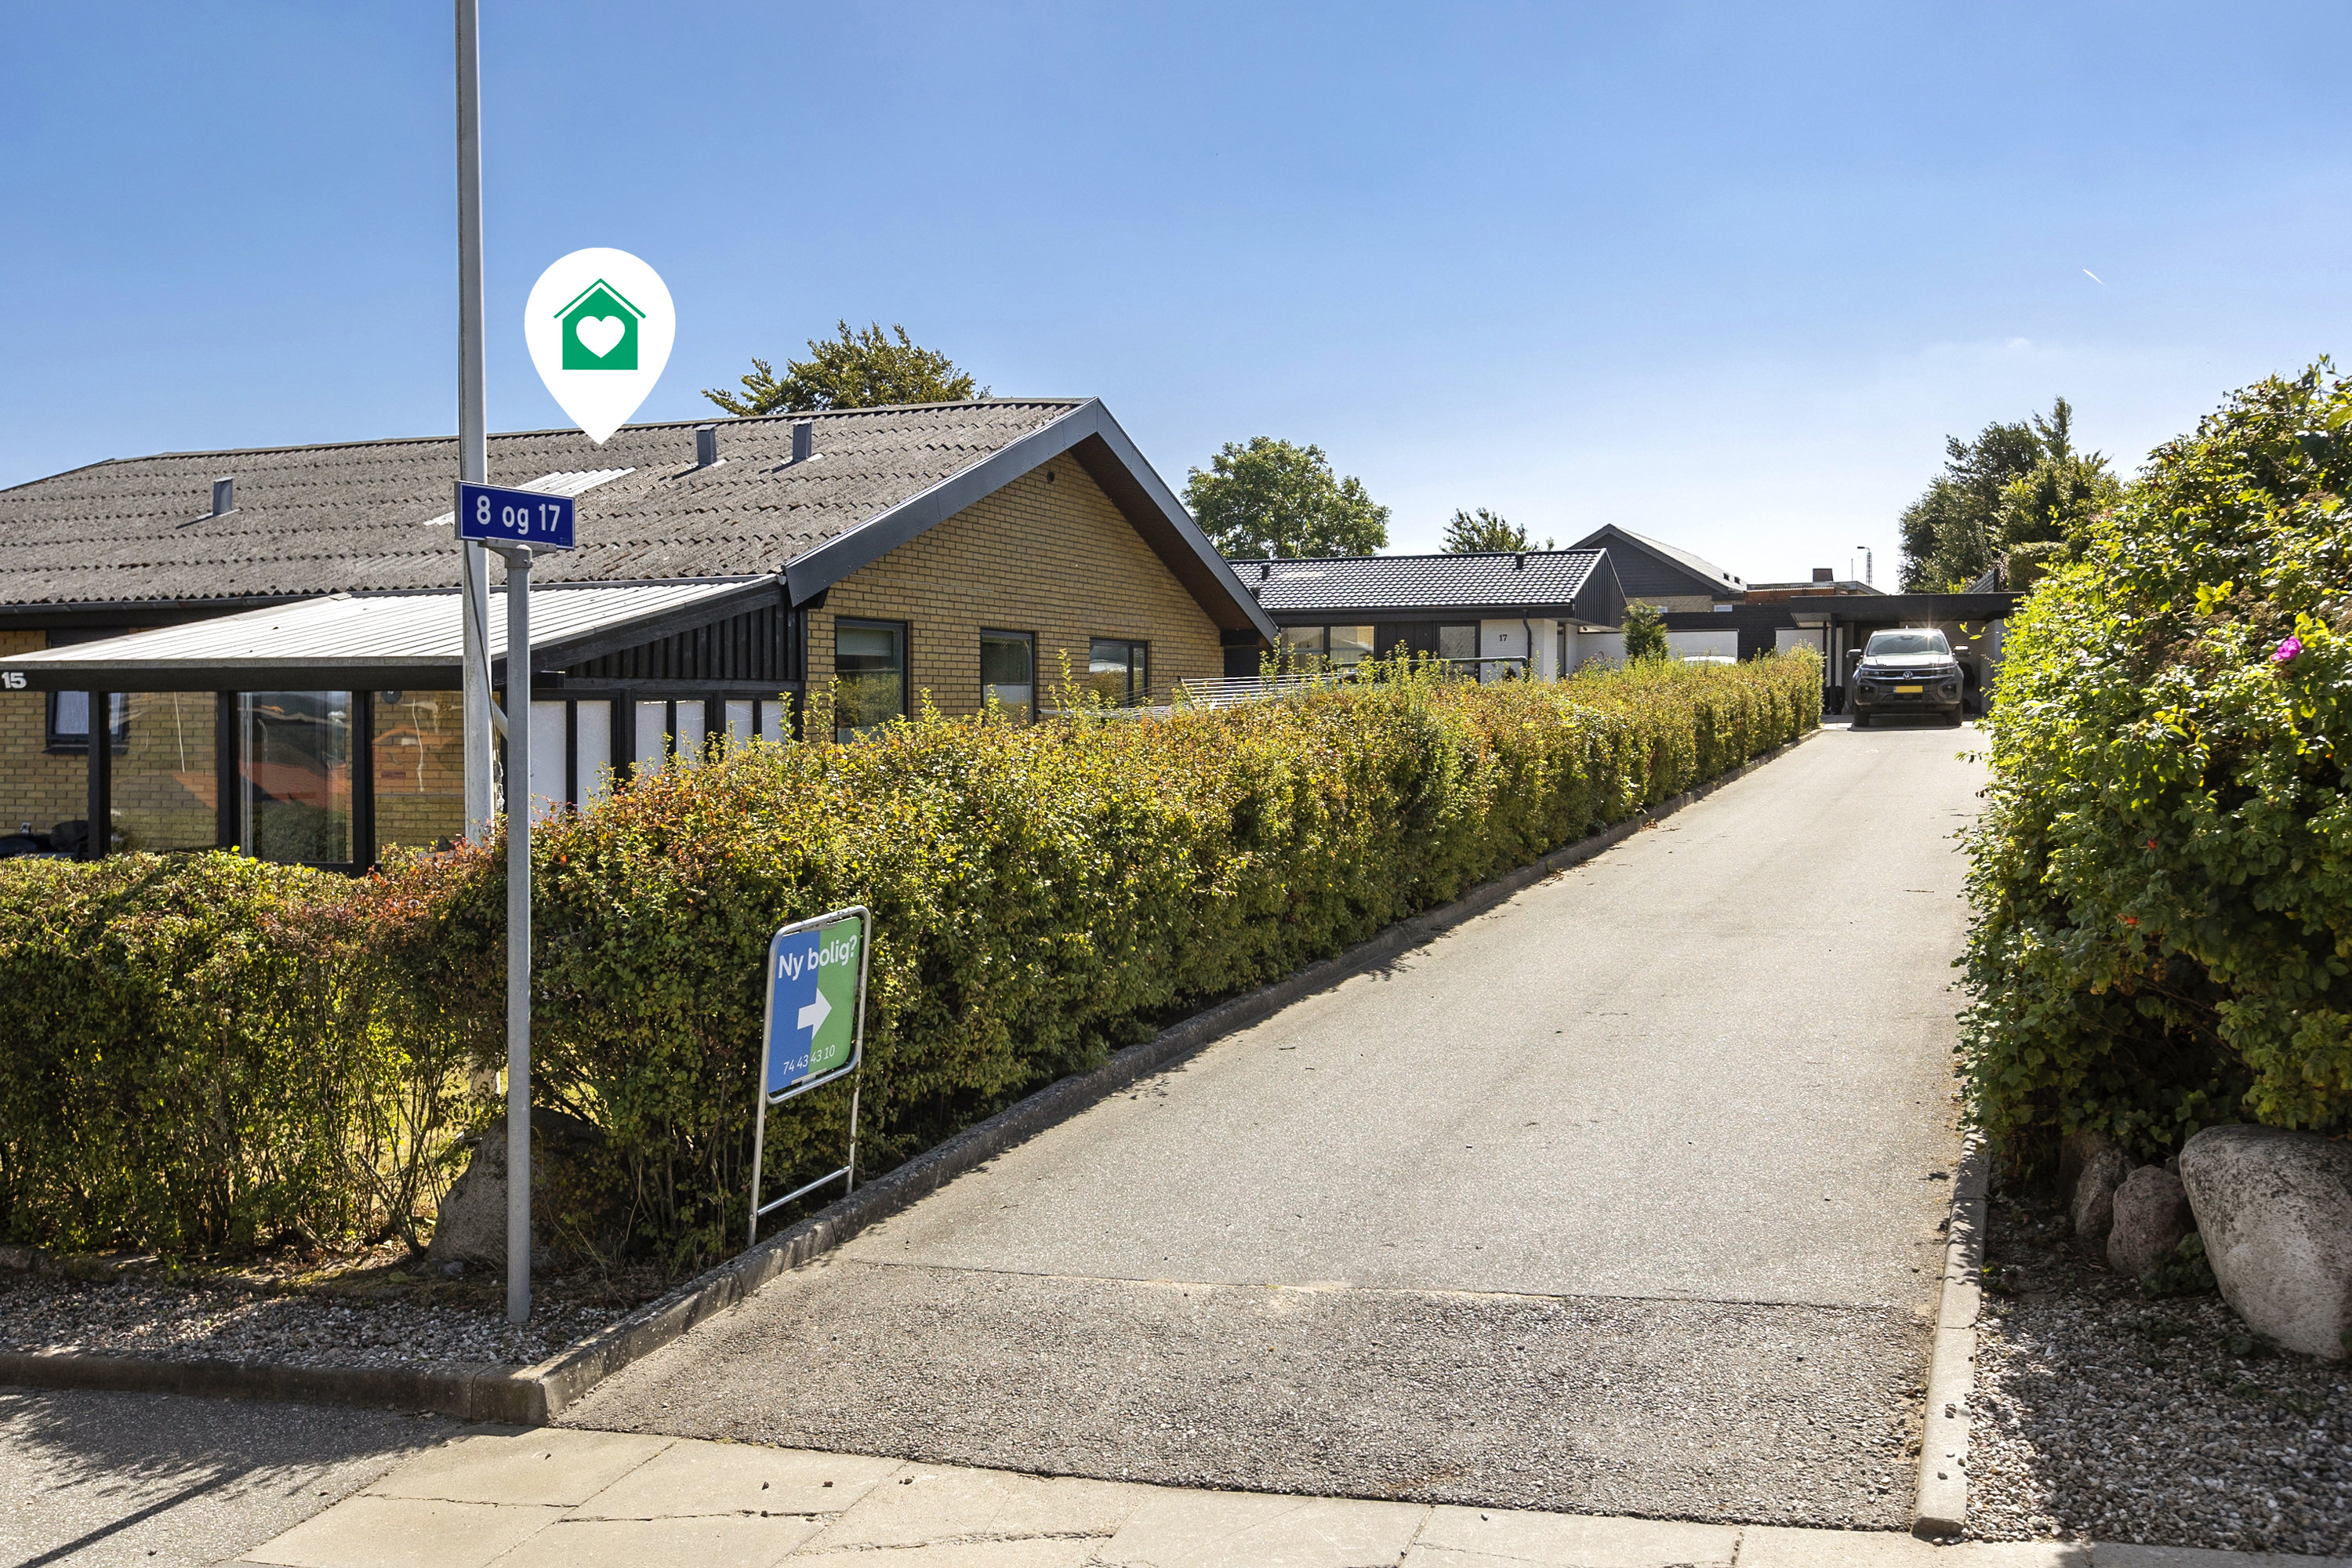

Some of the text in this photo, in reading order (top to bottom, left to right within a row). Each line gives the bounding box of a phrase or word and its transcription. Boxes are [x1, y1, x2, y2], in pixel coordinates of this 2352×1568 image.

[477, 495, 561, 535] 8 og 17
[1, 671, 27, 689] 15
[779, 935, 857, 980] Ny bolig?
[784, 1044, 835, 1075] 74 43 43 10
